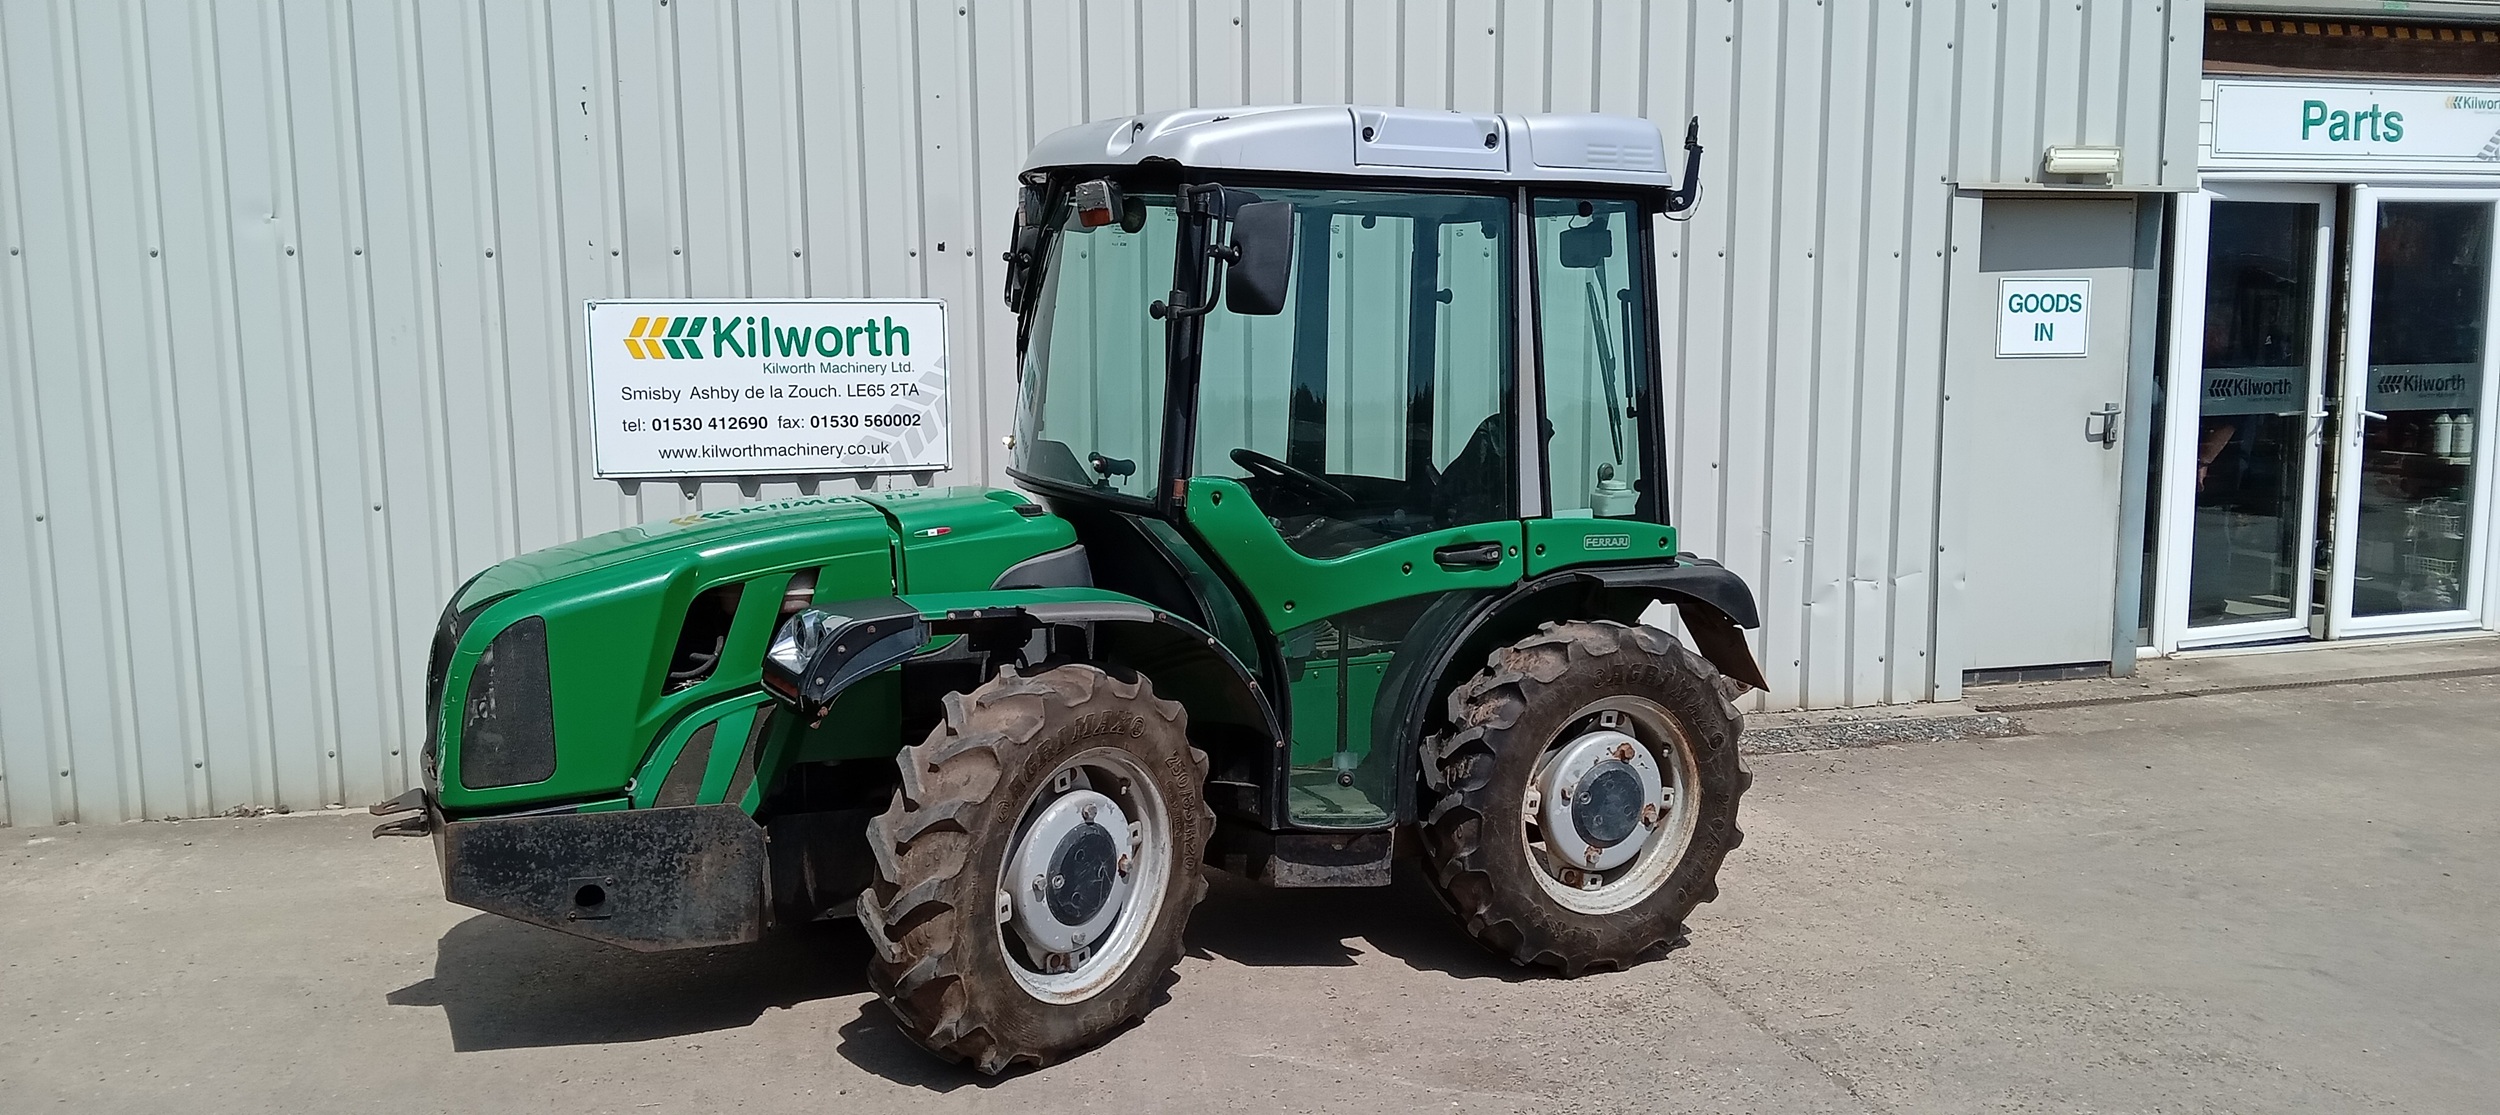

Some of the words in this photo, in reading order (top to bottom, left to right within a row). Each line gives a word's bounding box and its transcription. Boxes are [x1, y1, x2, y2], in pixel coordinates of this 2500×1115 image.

[2302, 100, 2404, 142] Parts
[2008, 294, 2082, 313] GOODS
[713, 316, 910, 358] Kilworth
[2034, 322, 2053, 341] IN
[763, 362, 816, 374] Kilworth
[820, 362, 887, 376] Machinery
[891, 361, 915, 373] Ltd.
[2233, 378, 2292, 396] Kilworth
[2404, 374, 2465, 392] Kilworth
[621, 386, 681, 403] Smisby
[690, 385, 740, 401] Ashby
[745, 385, 765, 399] de
[769, 385, 783, 398] la
[788, 384, 842, 398] Zouch.
[847, 383, 886, 397] LE65
[890, 383, 919, 396] 2TA
[622, 418, 646, 432] tel:
[652, 417, 702, 431] 01530
[708, 417, 768, 430] 412690
[777, 415, 805, 429] fax:
[810, 415, 859, 428] 01530
[864, 413, 921, 427] 560002
[658, 442, 889, 460] www.kilworthmachinery.co.uk
[1586, 537, 1628, 547] FERRARI
